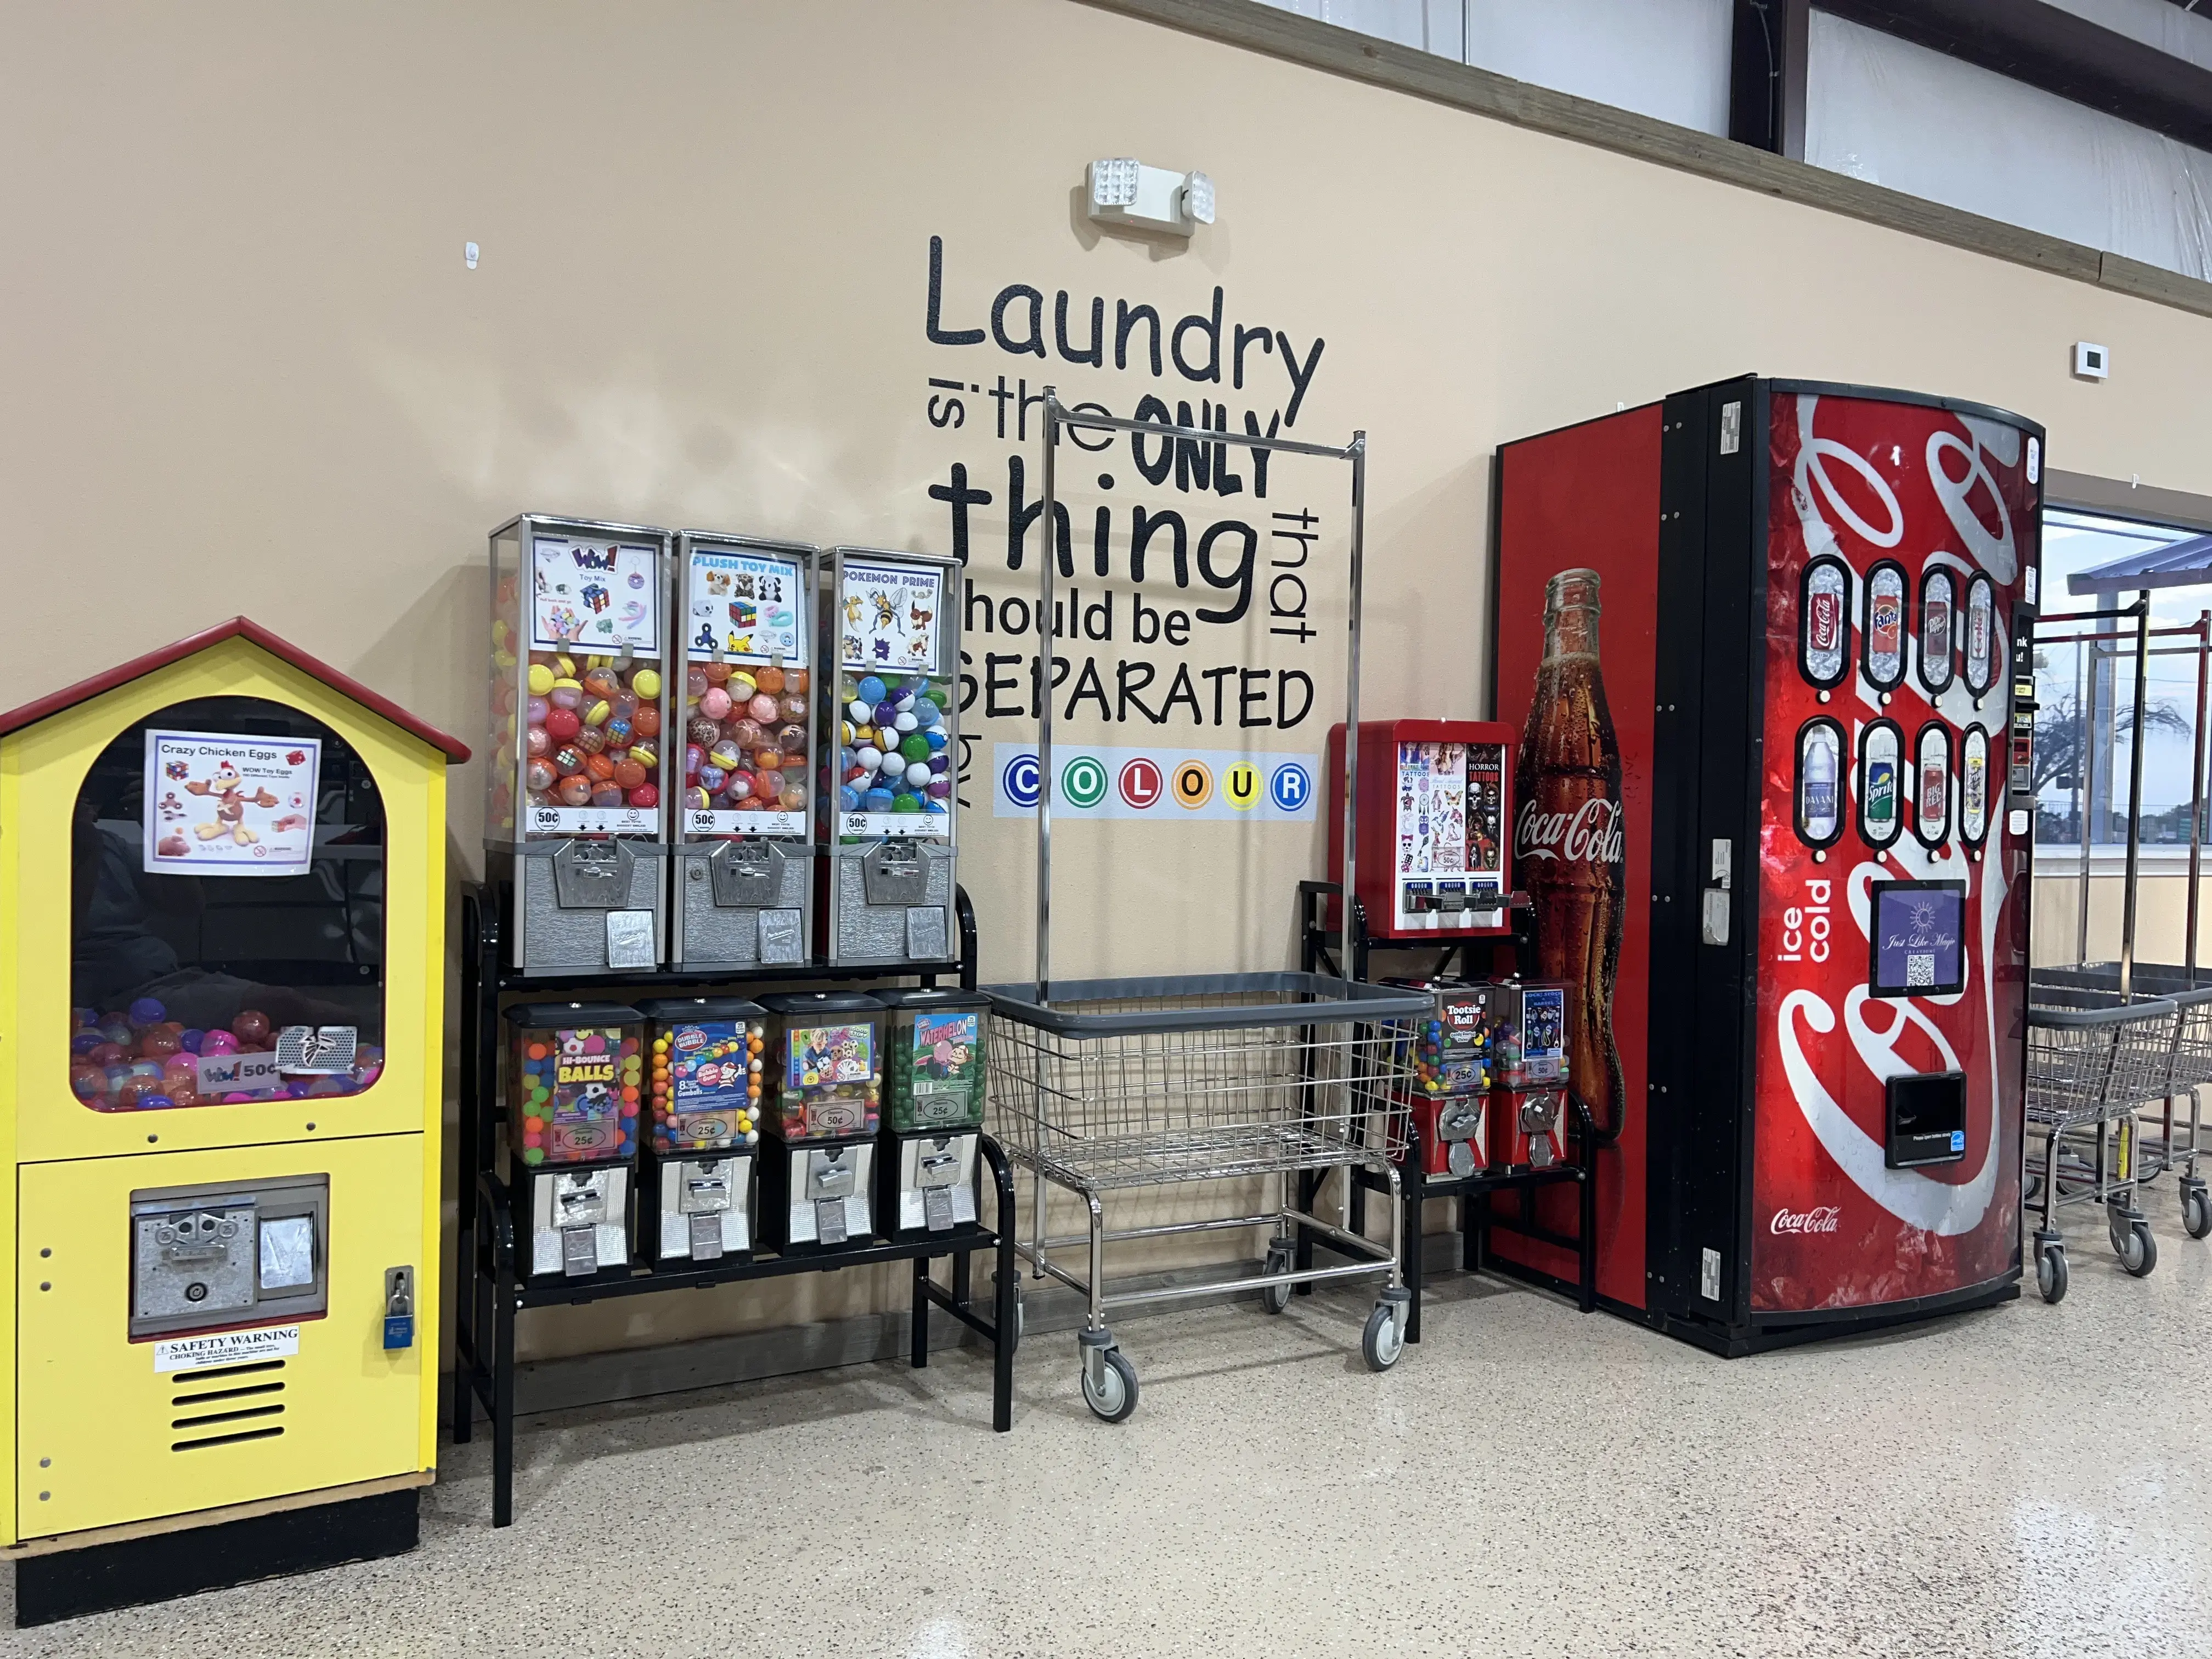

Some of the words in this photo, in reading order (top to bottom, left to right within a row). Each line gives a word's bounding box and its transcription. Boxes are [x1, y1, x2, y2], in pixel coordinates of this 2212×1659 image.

[927, 236, 1325, 427] Laundry
[928, 377, 979, 429] is
[989, 376, 1116, 452] the
[1131, 394, 1279, 498] ONLY
[928, 455, 1257, 624] thing
[692, 556, 738, 569] PLUSH
[741, 561, 767, 573] TOY
[769, 565, 793, 577] MIX
[843, 571, 898, 584] POKEMON
[902, 576, 935, 588] PRIME
[1270, 507, 1319, 644] that
[965, 579, 1113, 641] hould
[1132, 592, 1190, 646] be
[1815, 596, 1831, 647] Coca-Cola
[947, 651, 1314, 729] SEPARATED
[161, 744, 195, 757] Crazy
[200, 746, 246, 757] Chicken
[249, 749, 278, 760] Eggs
[1469, 771, 1499, 782] TATTOOS
[1927, 783, 1940, 797] BIG
[1806, 795, 1833, 804] DASANI
[538, 812, 558, 823] 50¢
[696, 814, 714, 825] 50¢
[849, 817, 866, 828] 50¢
[1514, 798, 1622, 864] Coca-Cola
[1805, 879, 1831, 963] cold
[1778, 906, 1803, 962] ice
[1882, 934, 1906, 950] Just
[1908, 933, 1929, 947] Like
[1930, 933, 1956, 951] Magic
[1447, 1005, 1481, 1015] Tootsie
[1454, 1015, 1474, 1025] Roll
[677, 1033, 703, 1043] DUBBLE
[920, 1018, 967, 1047] WATERMELON
[679, 1039, 704, 1048] BUBBLE
[562, 1054, 611, 1065] HI-BOUNCE
[558, 1065, 614, 1084] BALLS
[698, 1067, 719, 1078] Bubble
[1455, 1070, 1472, 1080] 25¢
[679, 1080, 686, 1090] 8
[678, 1088, 703, 1097] Gumballs
[933, 1107, 948, 1115] 25¢
[827, 1116, 843, 1125] 50¢
[698, 1126, 715, 1136] 25¢
[574, 1136, 593, 1146] 25¢
[1770, 1206, 1841, 1235] Coca-Cola
[171, 1337, 227, 1354] SAFETY
[231, 1329, 298, 1345] WARNING
[170, 1351, 206, 1361] CHOKING
[207, 1347, 239, 1356] HAZARD
